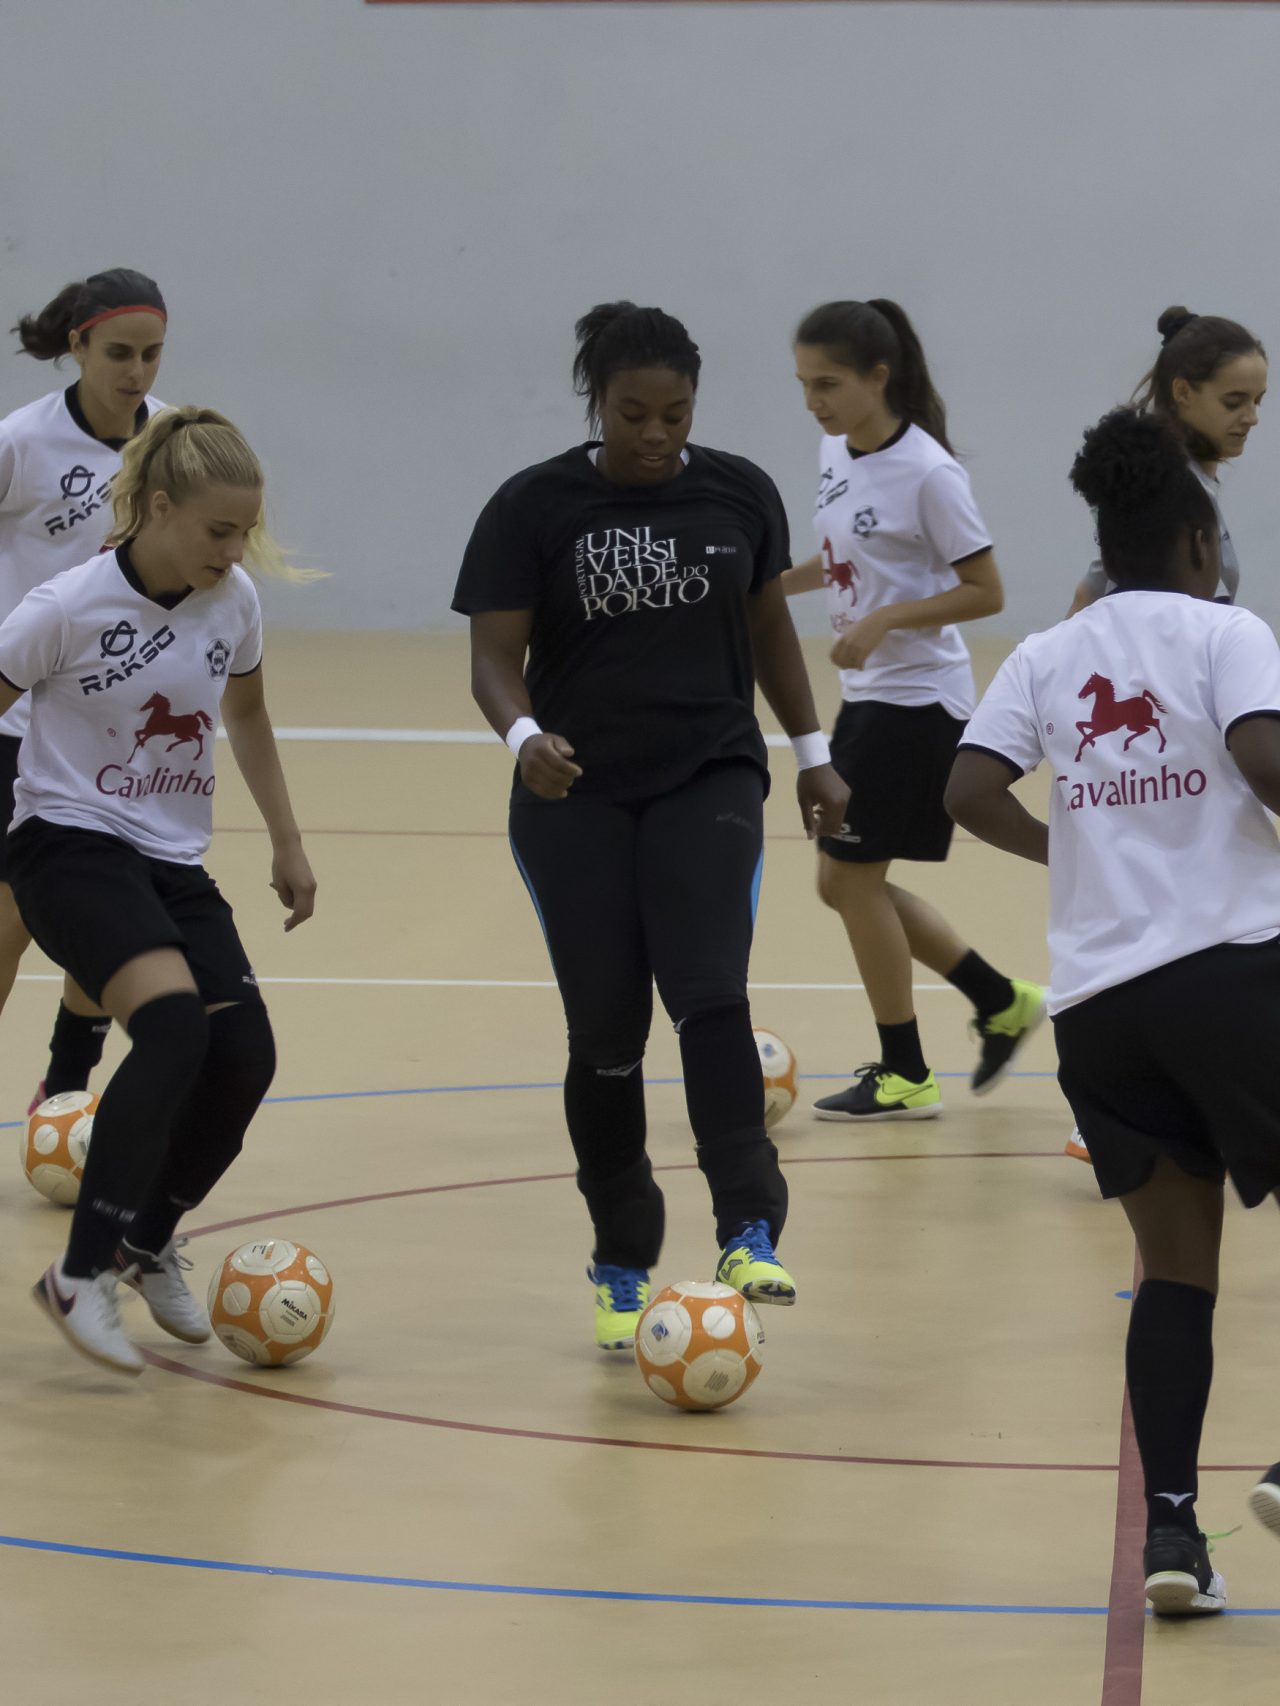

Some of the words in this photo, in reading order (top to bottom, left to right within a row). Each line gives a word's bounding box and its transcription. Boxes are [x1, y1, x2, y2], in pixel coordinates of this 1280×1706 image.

[44, 472, 119, 536] RAKS
[585, 526, 651, 553] UNI
[585, 538, 677, 574] VERSI
[575, 536, 588, 598] PORTUGAL
[587, 559, 678, 597] DADE
[683, 564, 709, 579] DO
[581, 576, 710, 621] PORTO
[78, 624, 176, 696] RAKSO
[1056, 764, 1207, 812] avalinho
